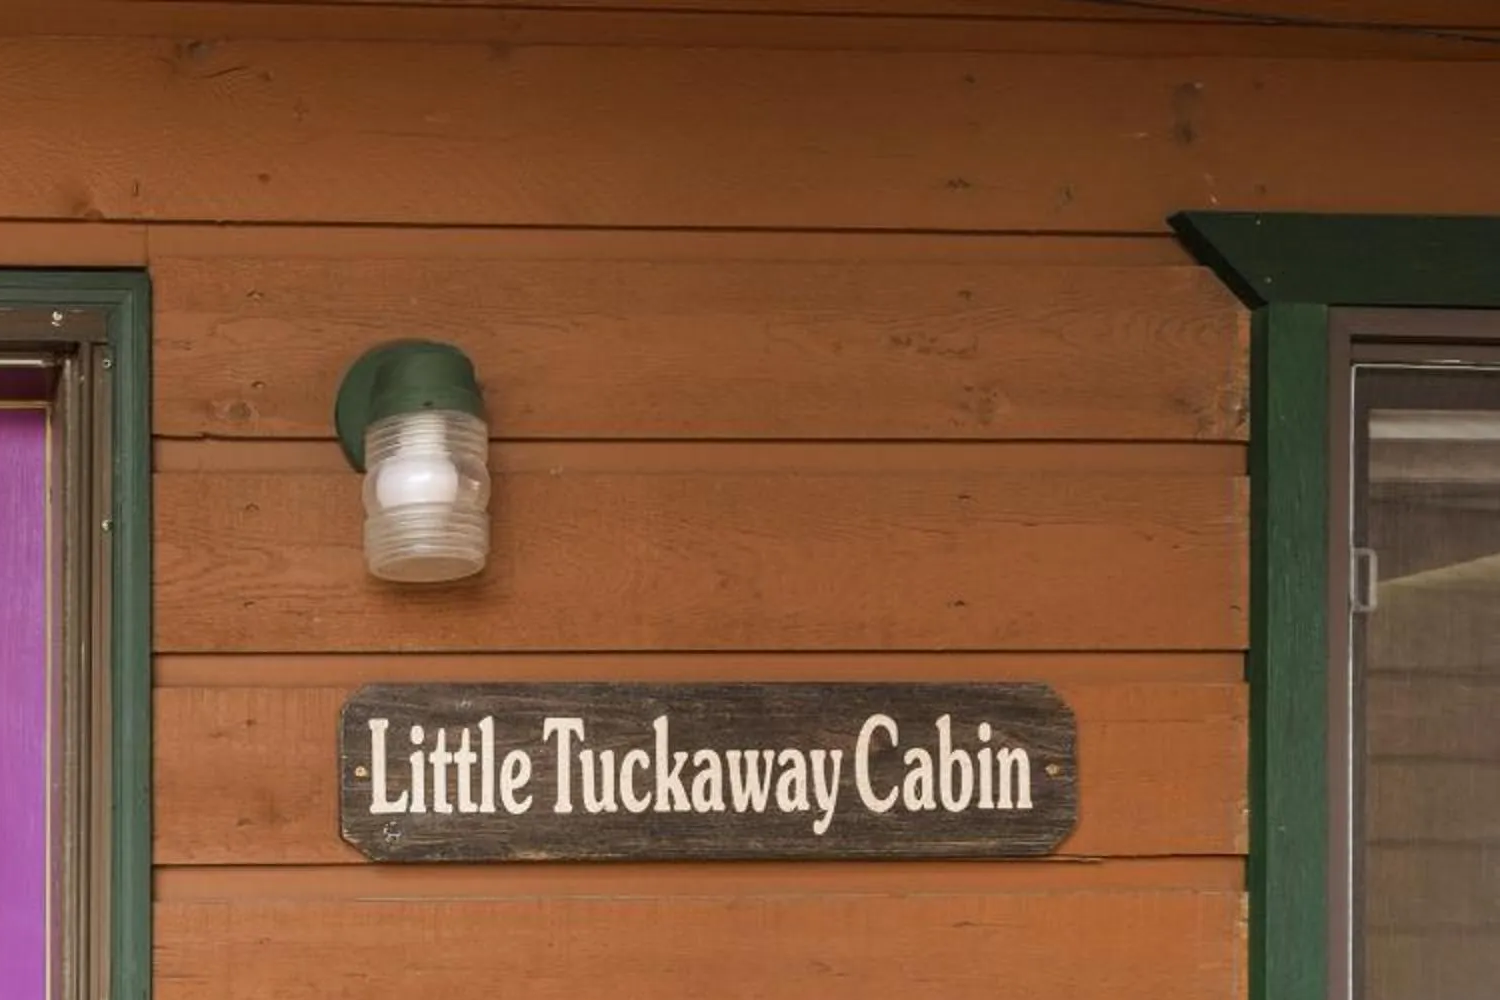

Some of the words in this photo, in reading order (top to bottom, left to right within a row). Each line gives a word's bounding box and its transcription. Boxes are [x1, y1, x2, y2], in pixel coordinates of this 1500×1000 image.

[368, 715, 533, 815] Little
[542, 715, 843, 836] Tuckaway
[855, 713, 1033, 813] Cabin
